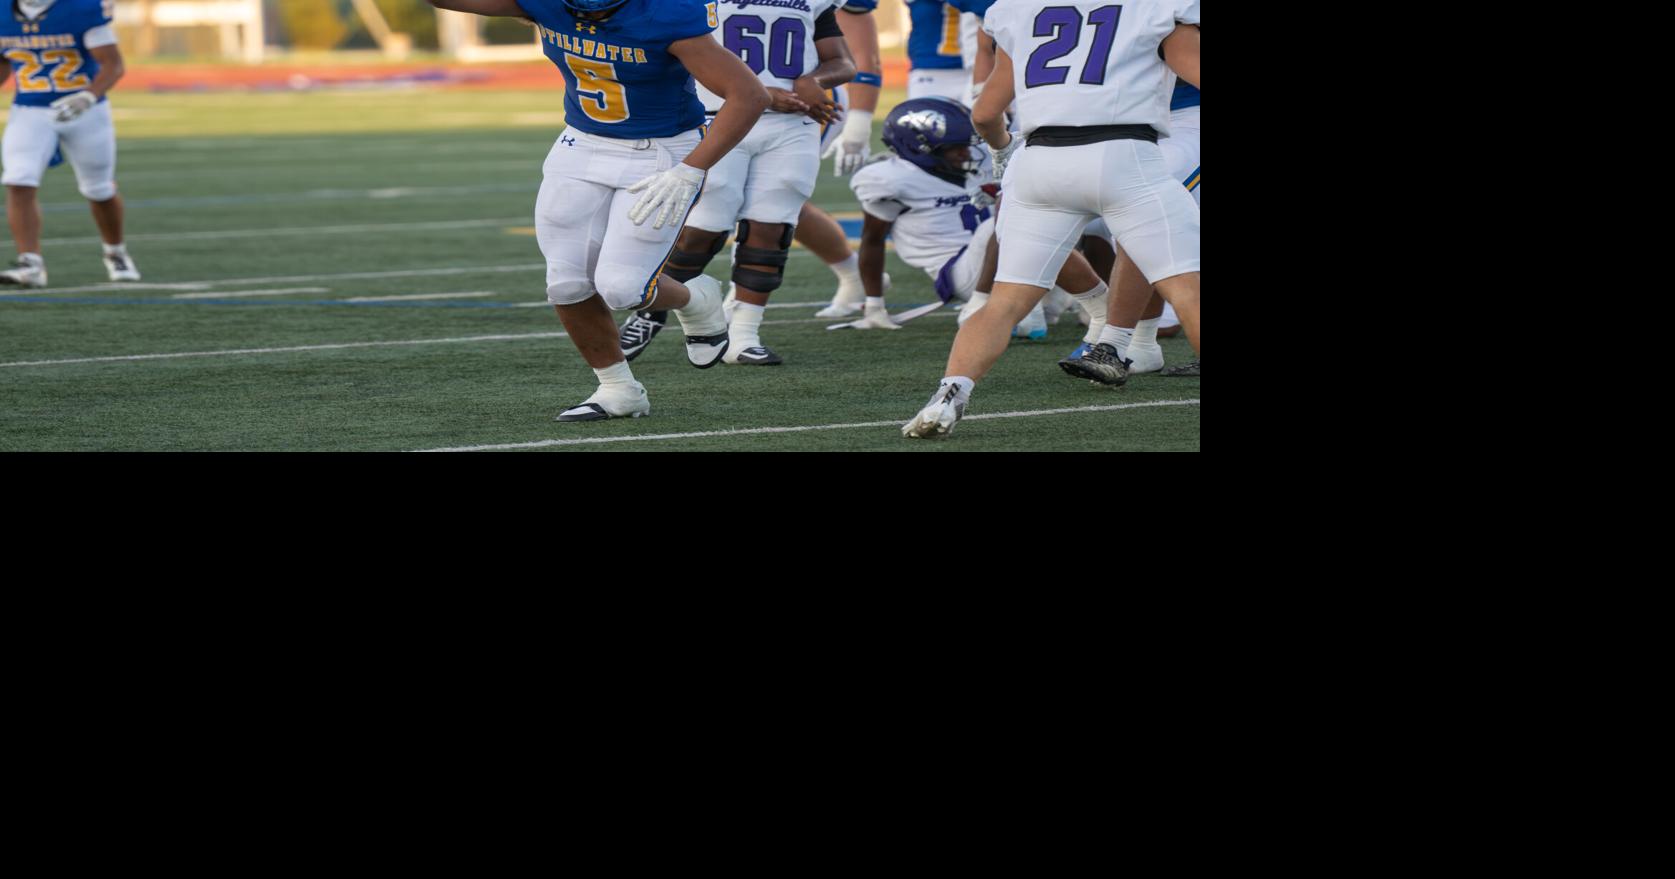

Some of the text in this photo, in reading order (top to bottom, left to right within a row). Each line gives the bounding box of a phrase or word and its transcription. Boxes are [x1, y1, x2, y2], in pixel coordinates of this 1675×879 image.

[704, 2, 719, 28] 5
[723, 14, 806, 80] 60
[1025, 4, 1123, 89] 21
[3, 49, 90, 93] 22
[564, 52, 630, 124] 5
